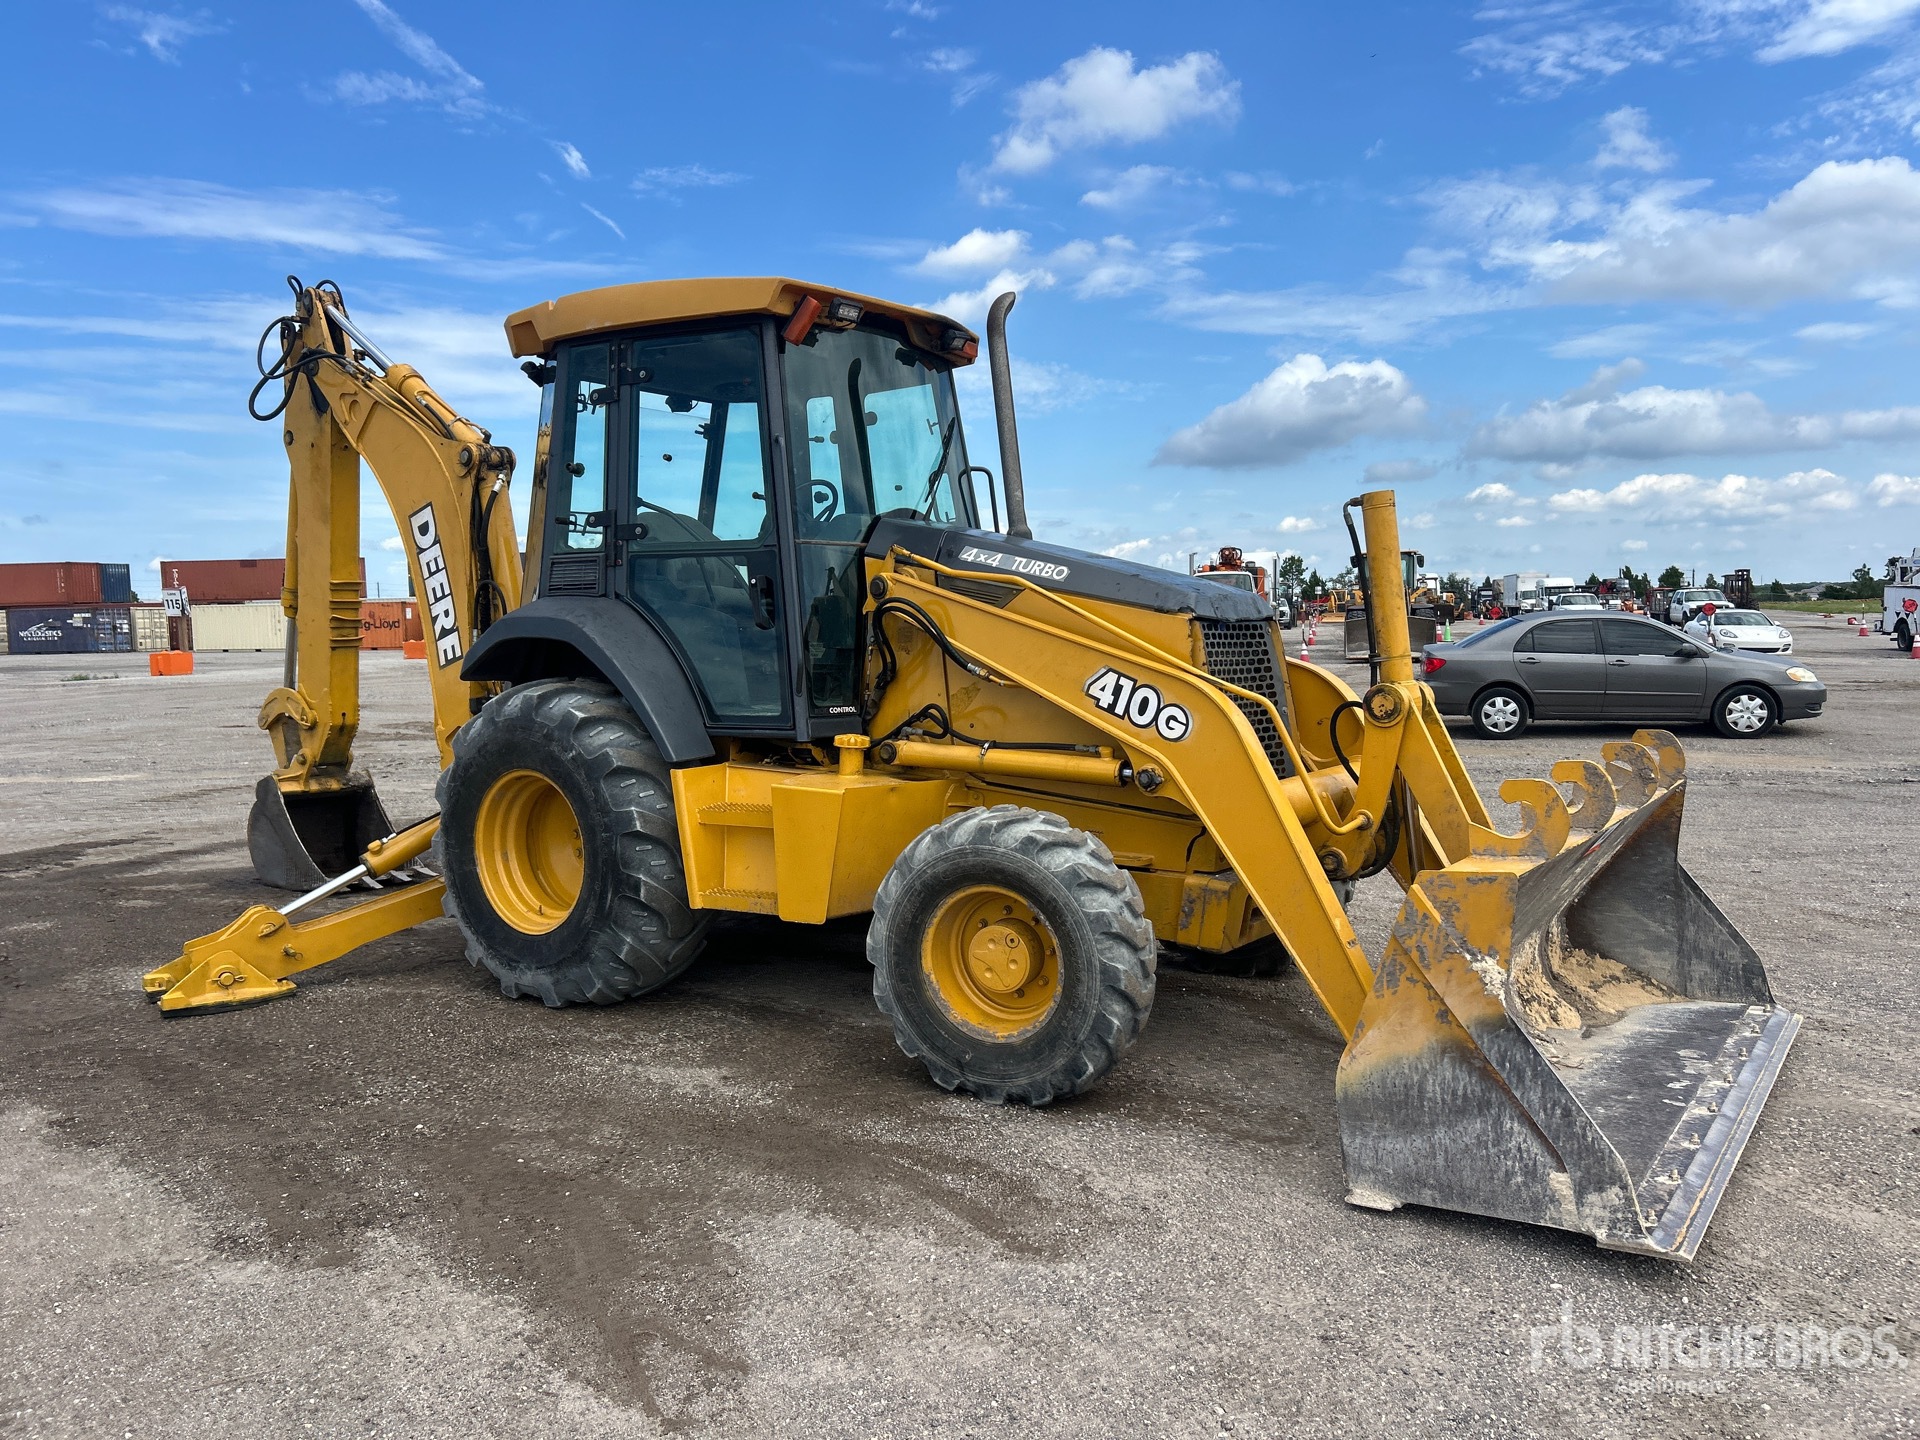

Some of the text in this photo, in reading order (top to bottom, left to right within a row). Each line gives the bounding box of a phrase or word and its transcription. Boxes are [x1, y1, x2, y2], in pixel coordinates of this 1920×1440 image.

[1013, 557, 1069, 581] TURBO
[409, 502, 463, 668] DEERE
[164, 598, 181, 610] 115
[362, 617, 400, 631] g-Lloyd
[829, 706, 857, 714] CONTROL
[1087, 669, 1191, 742] 410G
